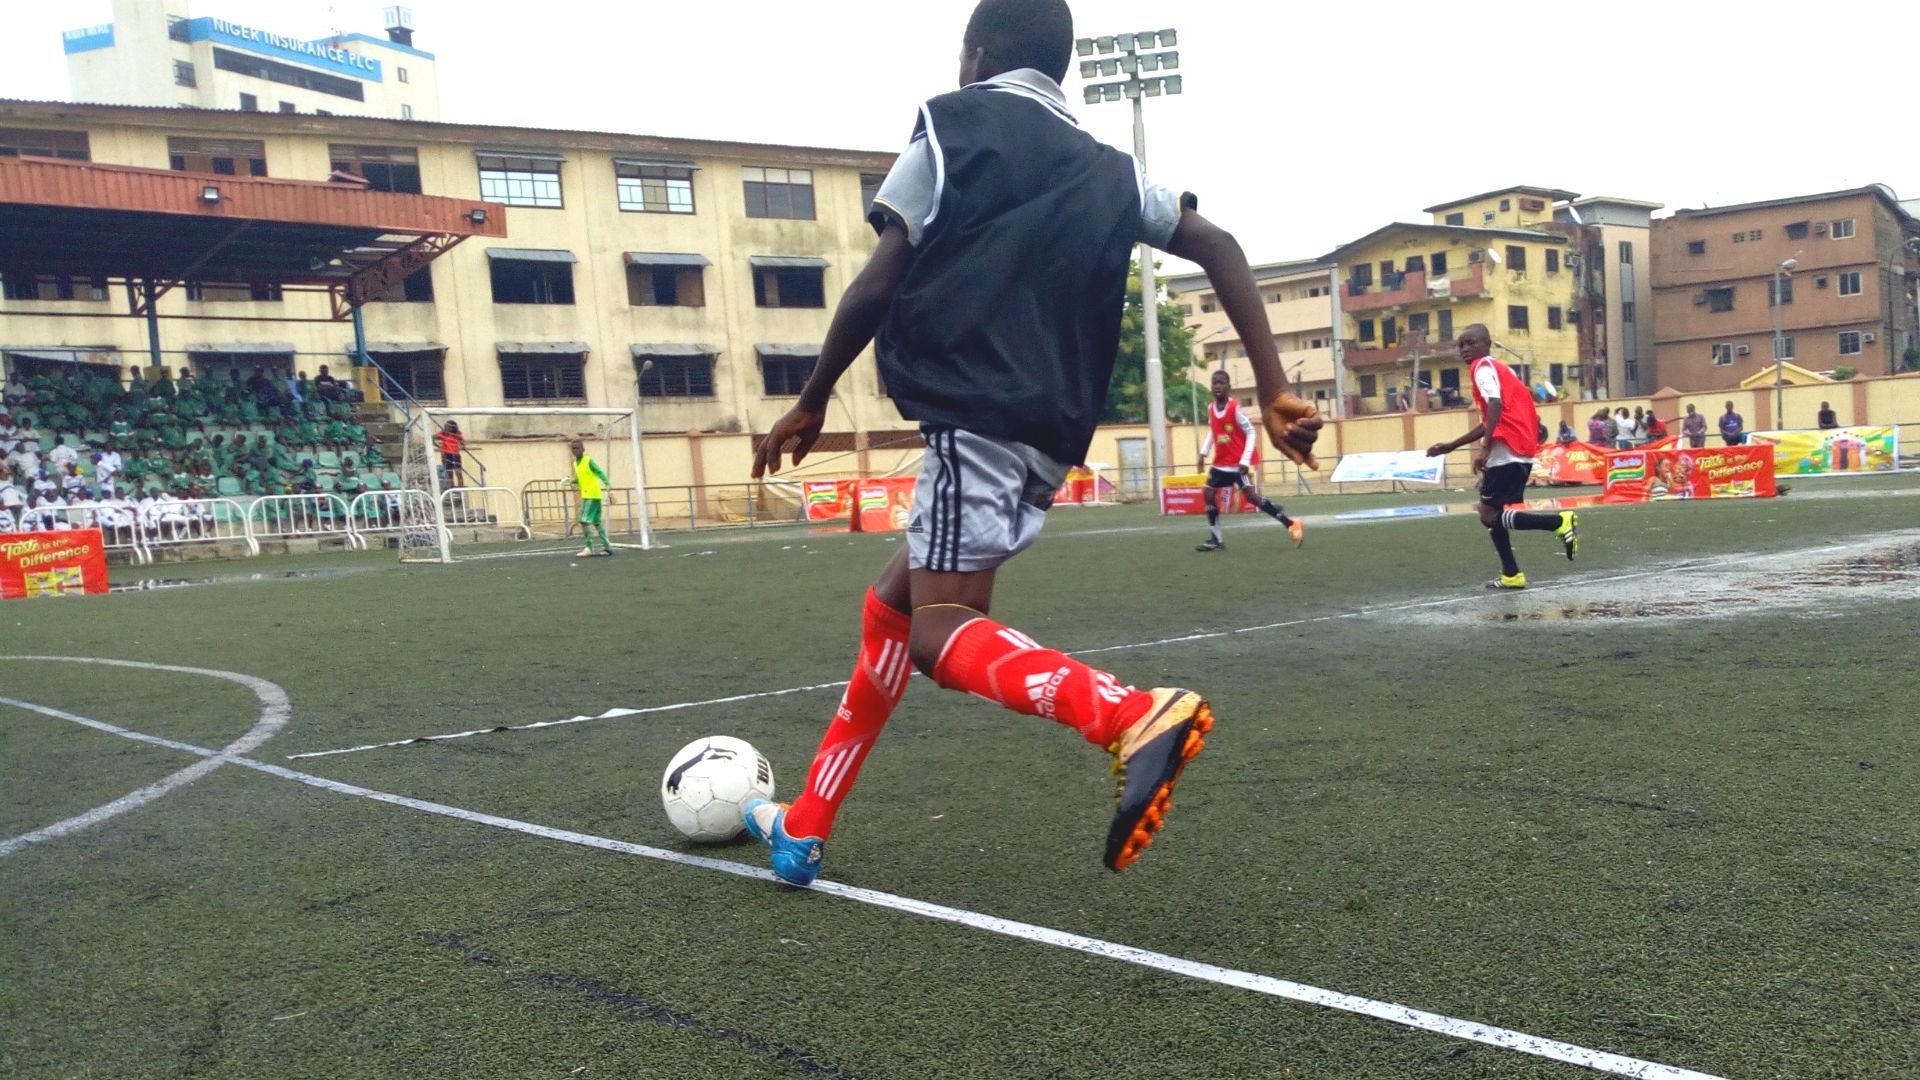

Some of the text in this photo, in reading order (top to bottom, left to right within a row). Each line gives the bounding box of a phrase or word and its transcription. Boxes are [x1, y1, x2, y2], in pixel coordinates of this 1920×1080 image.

[213, 18, 375, 71] NIGER INSURANCE PLC
[1708, 460, 1764, 480] Difference
[0, 538, 40, 560] Taste
[20, 545, 90, 569] Difference
